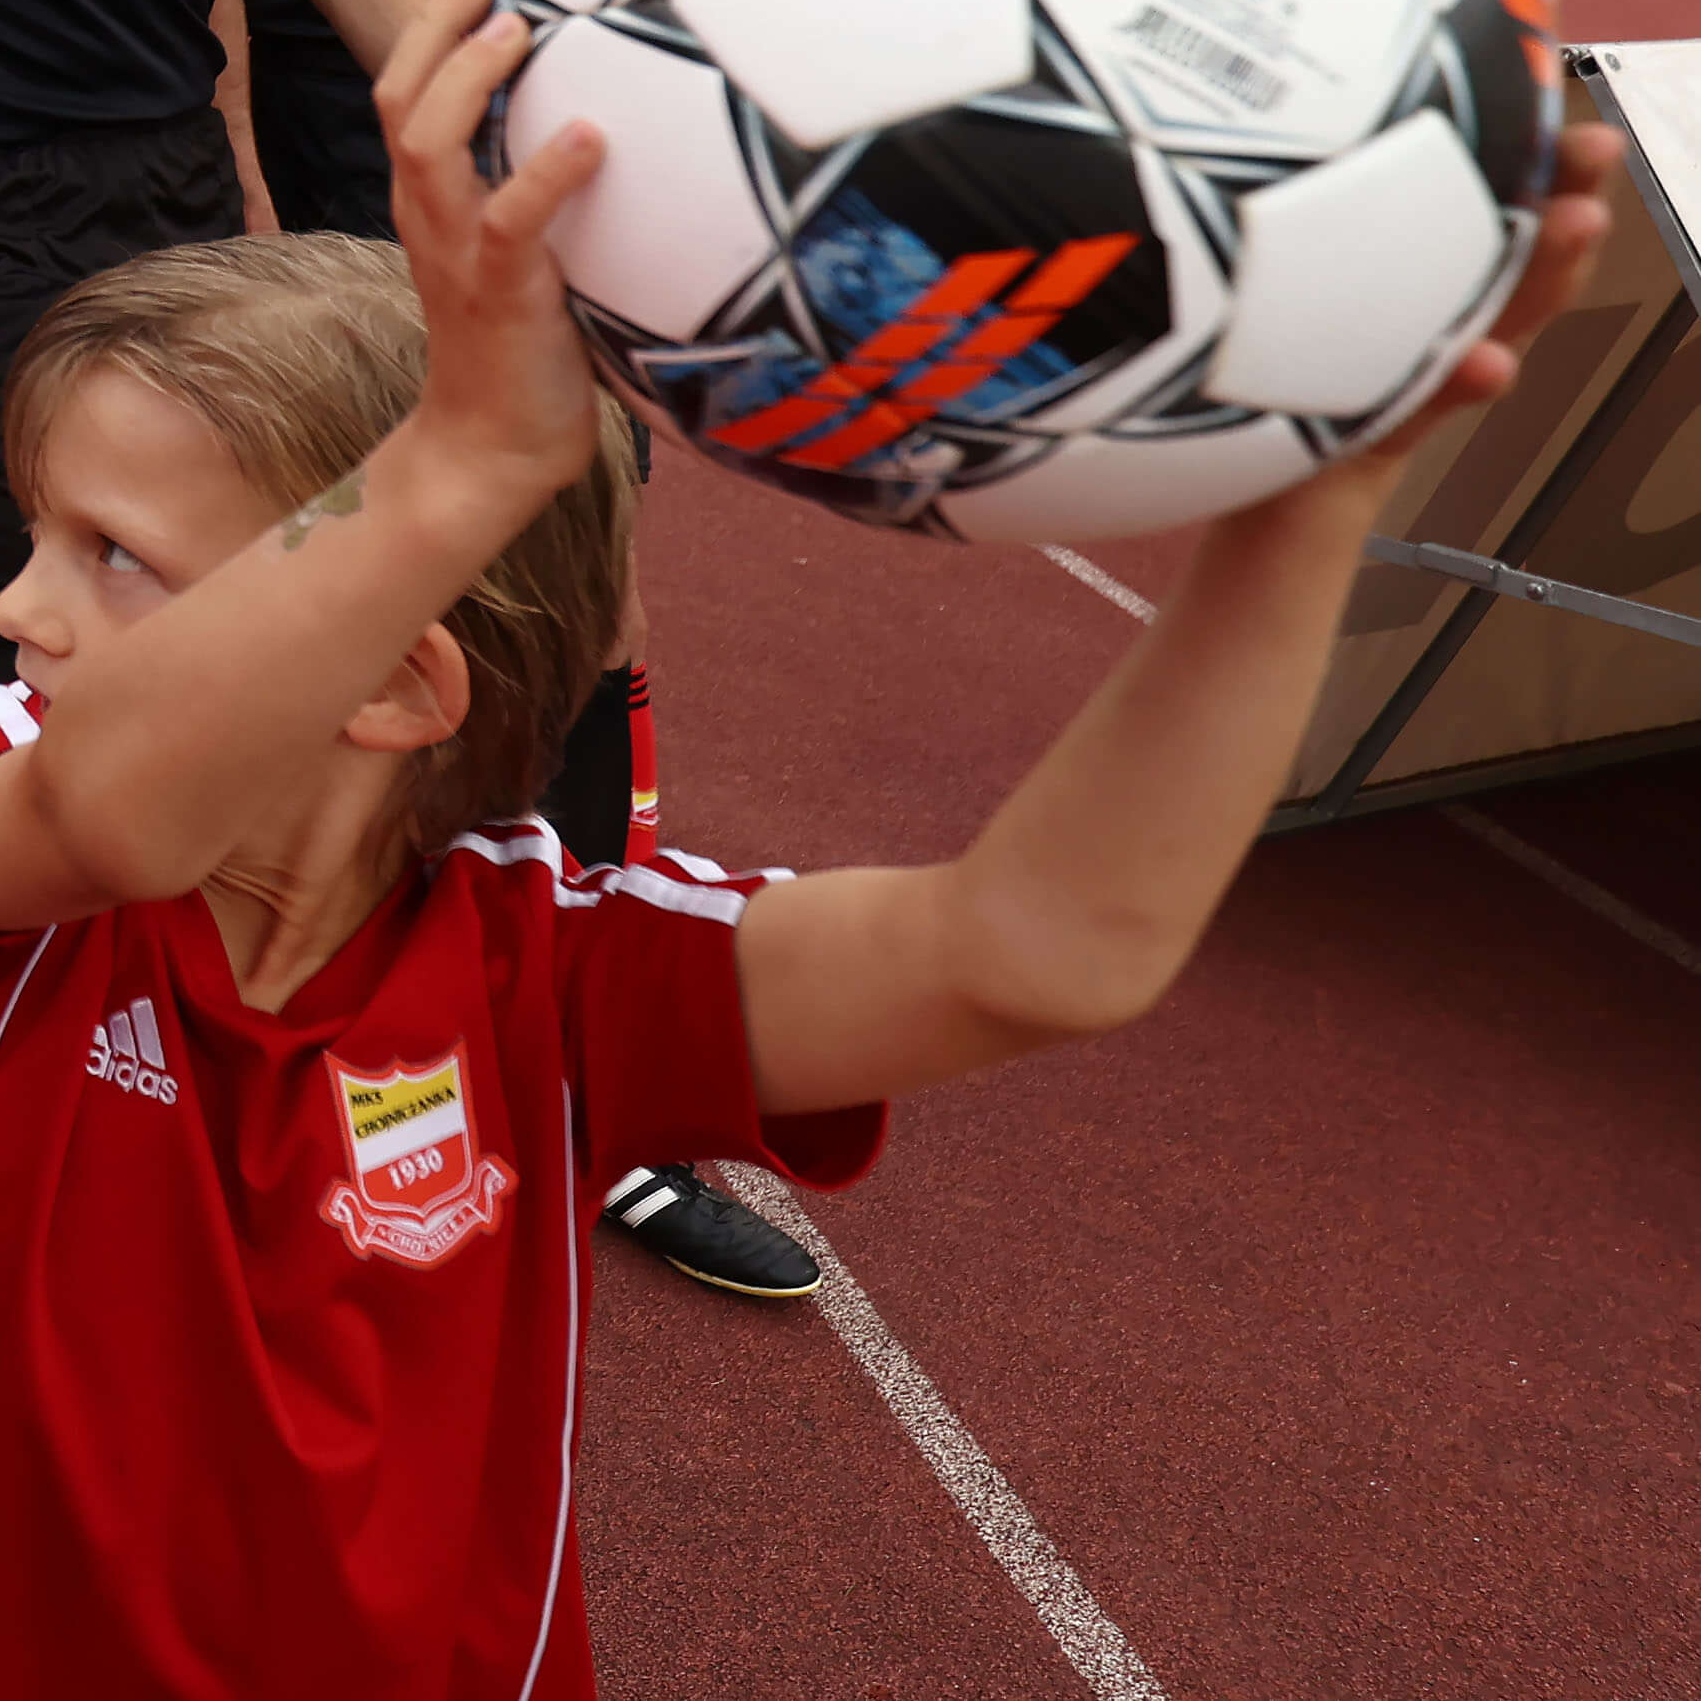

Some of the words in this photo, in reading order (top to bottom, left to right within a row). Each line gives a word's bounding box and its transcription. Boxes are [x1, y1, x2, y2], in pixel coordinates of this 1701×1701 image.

[351, 1090, 384, 1109] MKS
[354, 1086, 456, 1139] CHOJNICZANKA
[388, 1145, 444, 1190] 1930
